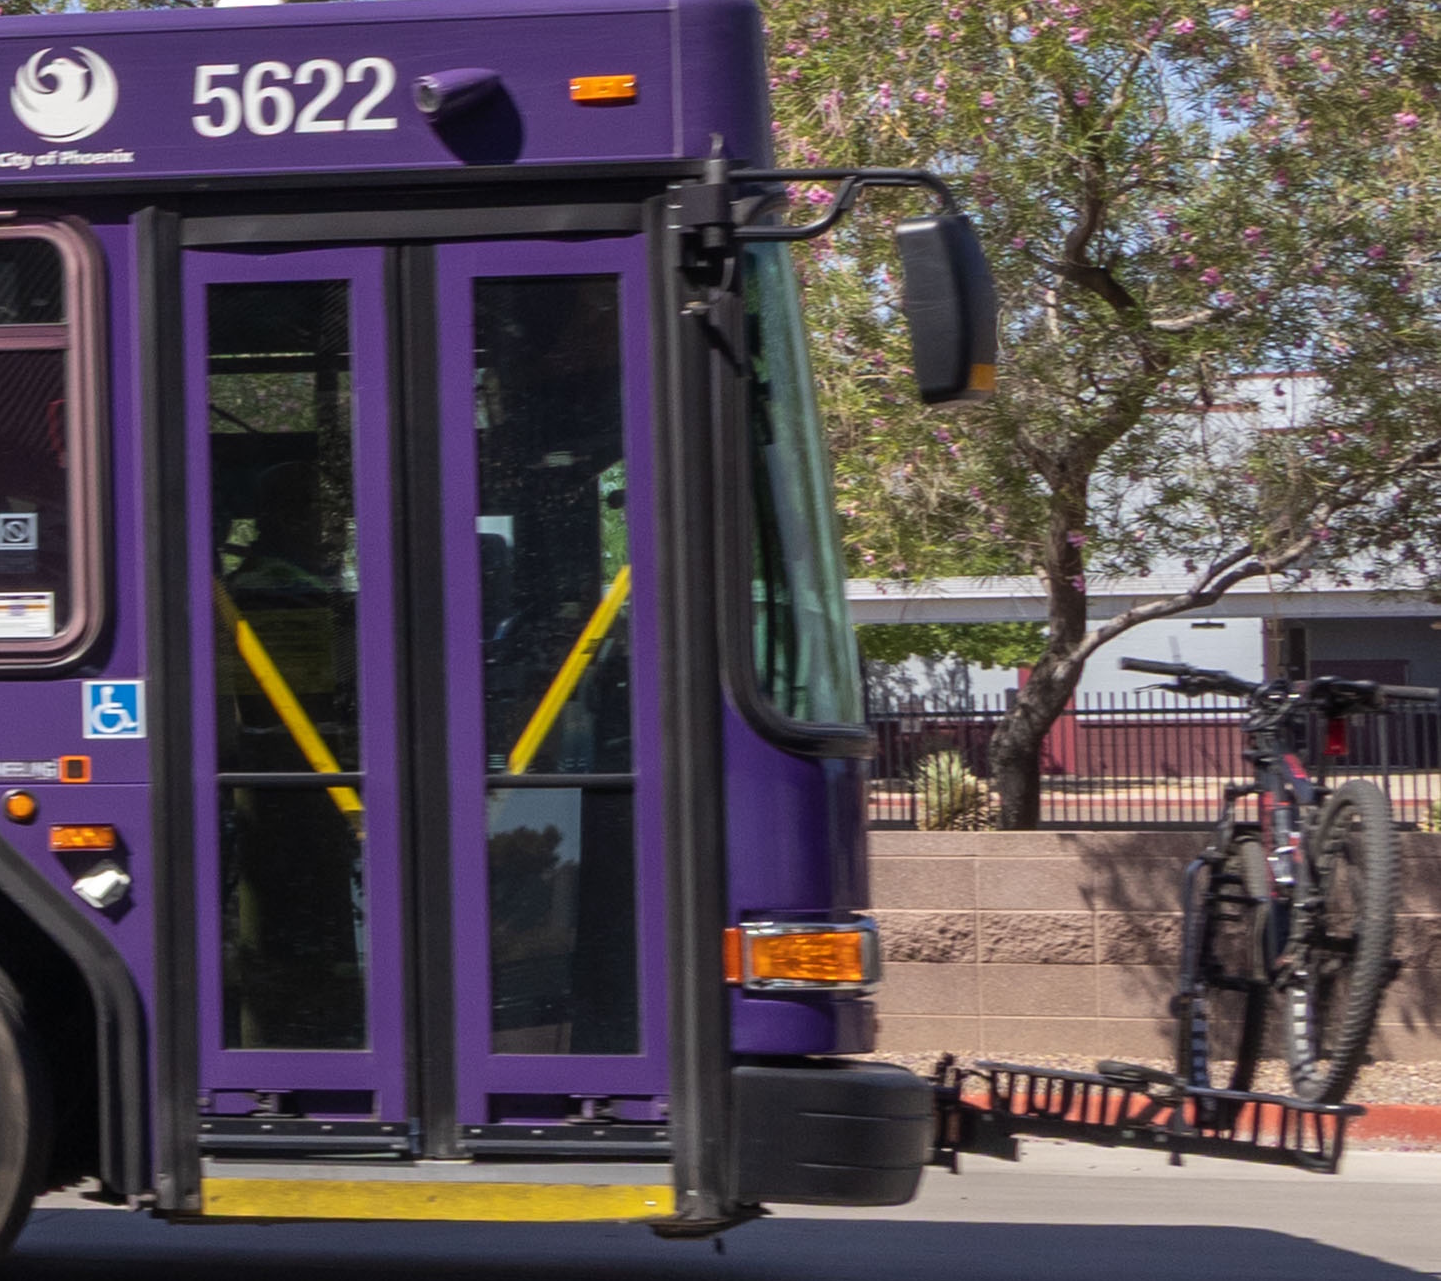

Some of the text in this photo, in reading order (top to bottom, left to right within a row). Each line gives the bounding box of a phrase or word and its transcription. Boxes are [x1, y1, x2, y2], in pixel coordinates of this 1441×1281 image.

[191, 56, 398, 138] 5622
[35, 150, 58, 166] of
[58, 148, 135, 165] Phoenix
